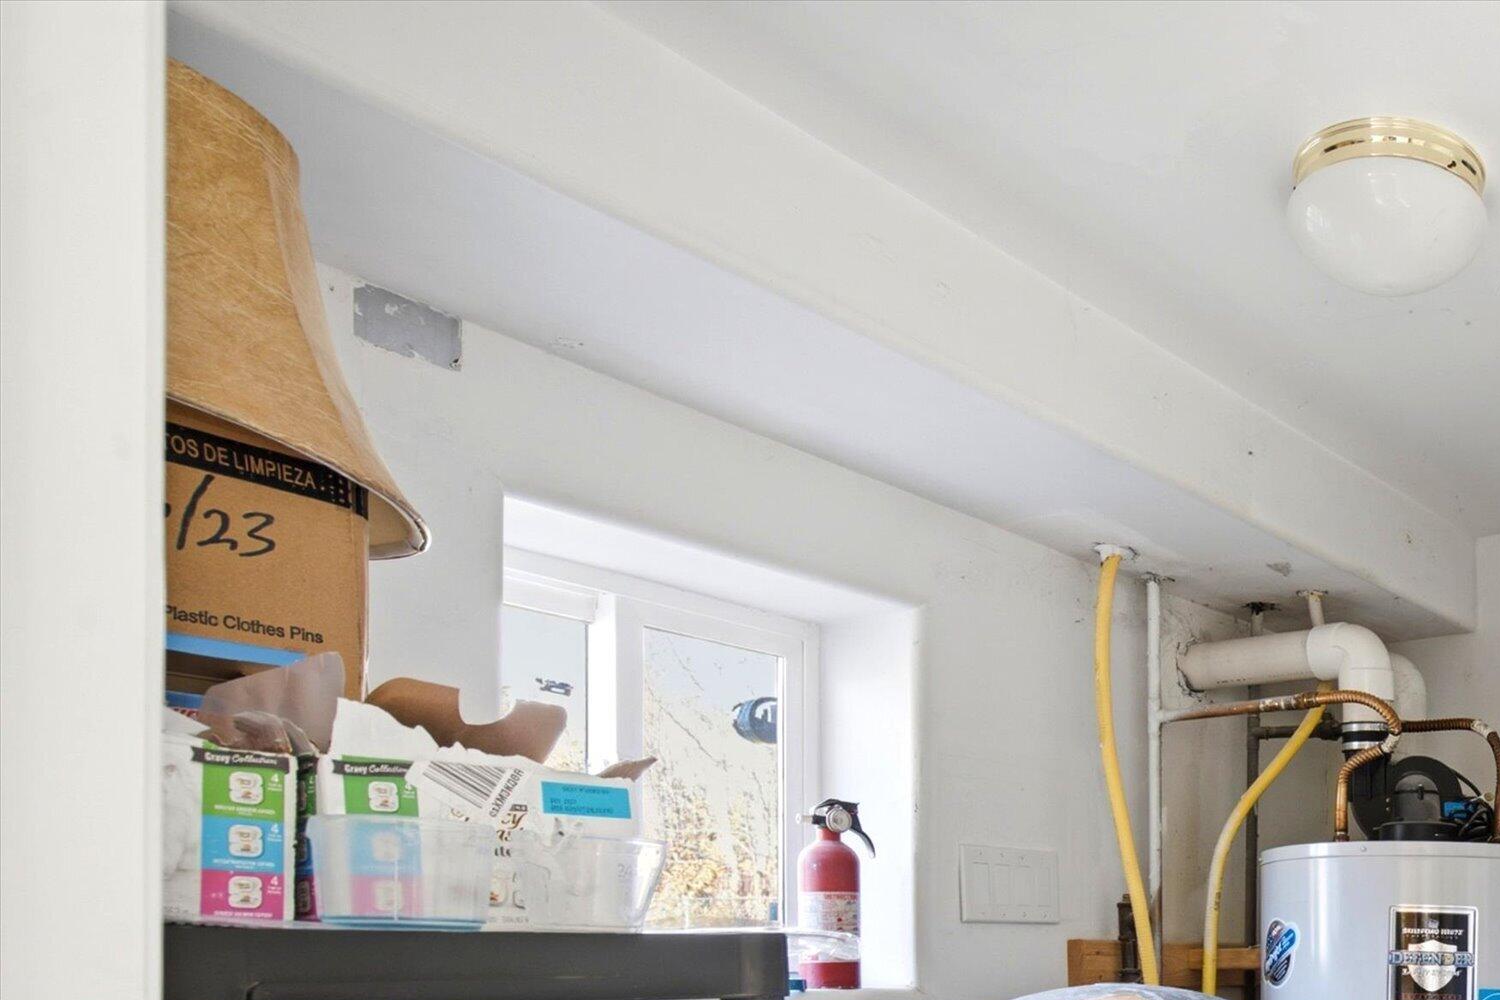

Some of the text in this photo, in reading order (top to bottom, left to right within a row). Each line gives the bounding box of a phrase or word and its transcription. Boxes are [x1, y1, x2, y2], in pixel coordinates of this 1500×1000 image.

[204, 443, 230, 467] DE
[233, 452, 316, 490] LIMPIEZA
[165, 474, 276, 557] /23
[223, 615, 285, 638] Clothes
[290, 626, 324, 644] Pins
[1388, 950, 1475, 967] DEFENDER
